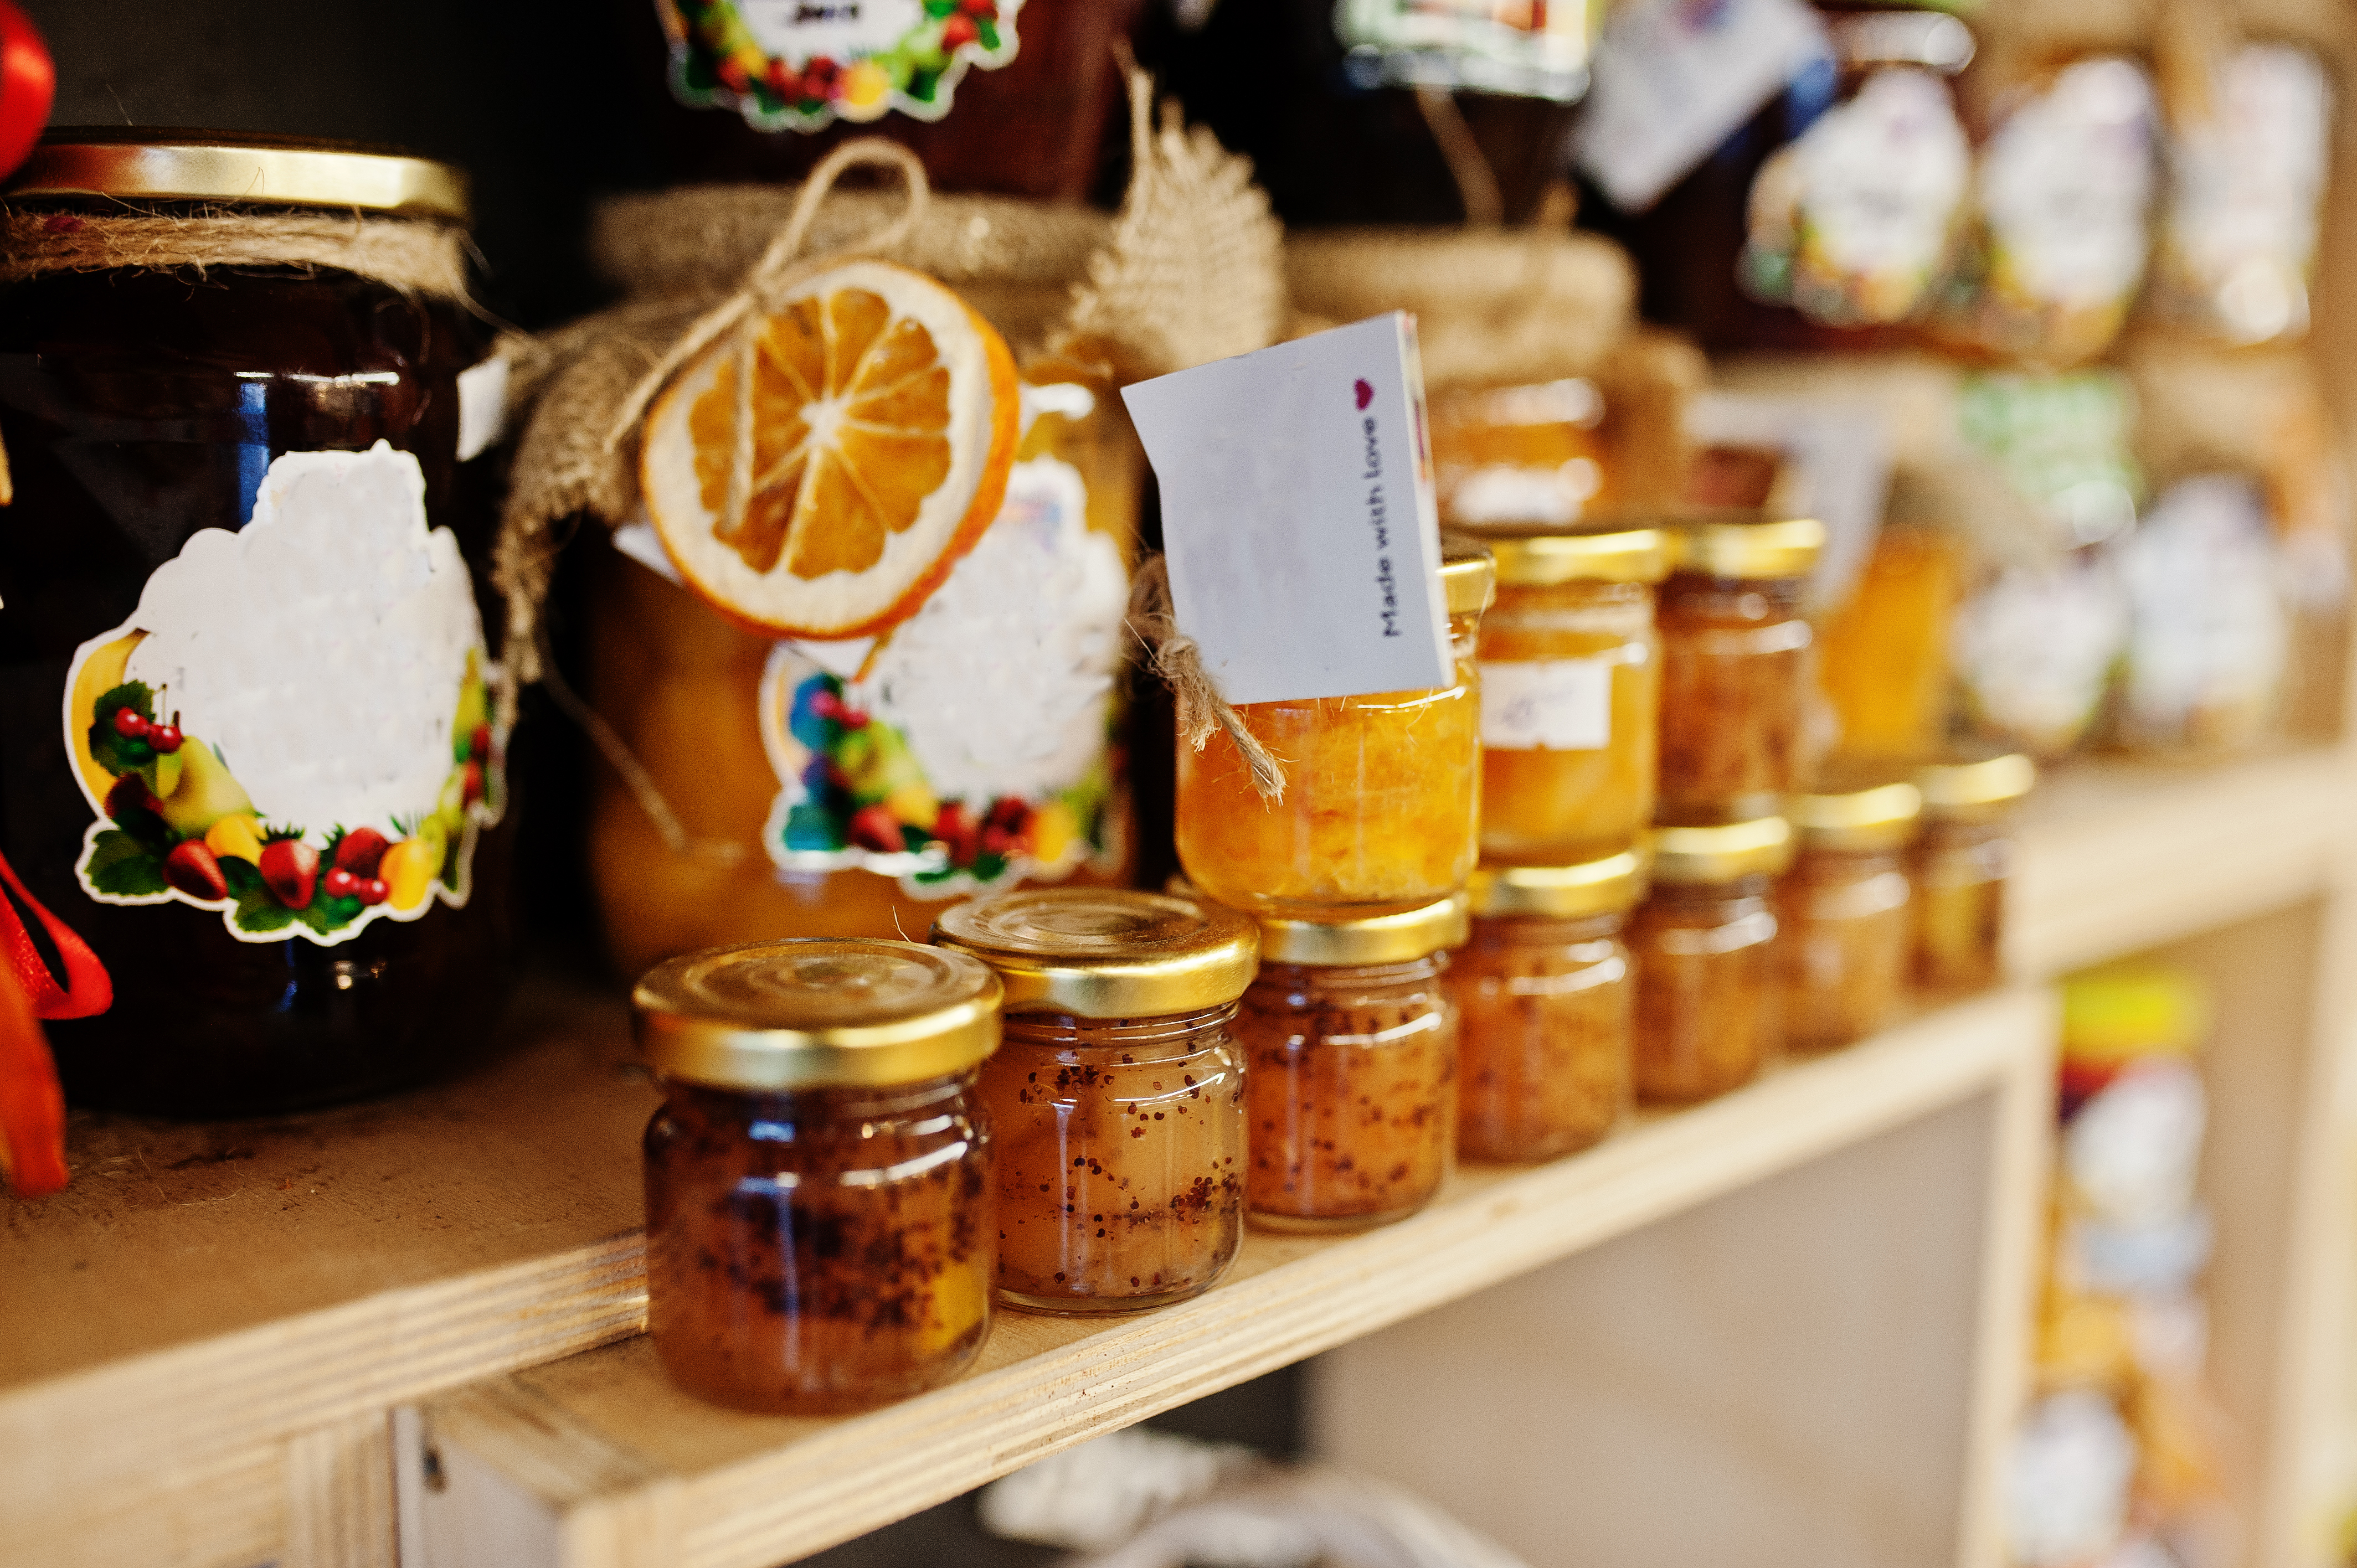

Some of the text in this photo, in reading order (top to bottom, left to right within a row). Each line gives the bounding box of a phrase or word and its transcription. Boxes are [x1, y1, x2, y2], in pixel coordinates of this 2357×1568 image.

[1363, 416, 1401, 637] Made with love
